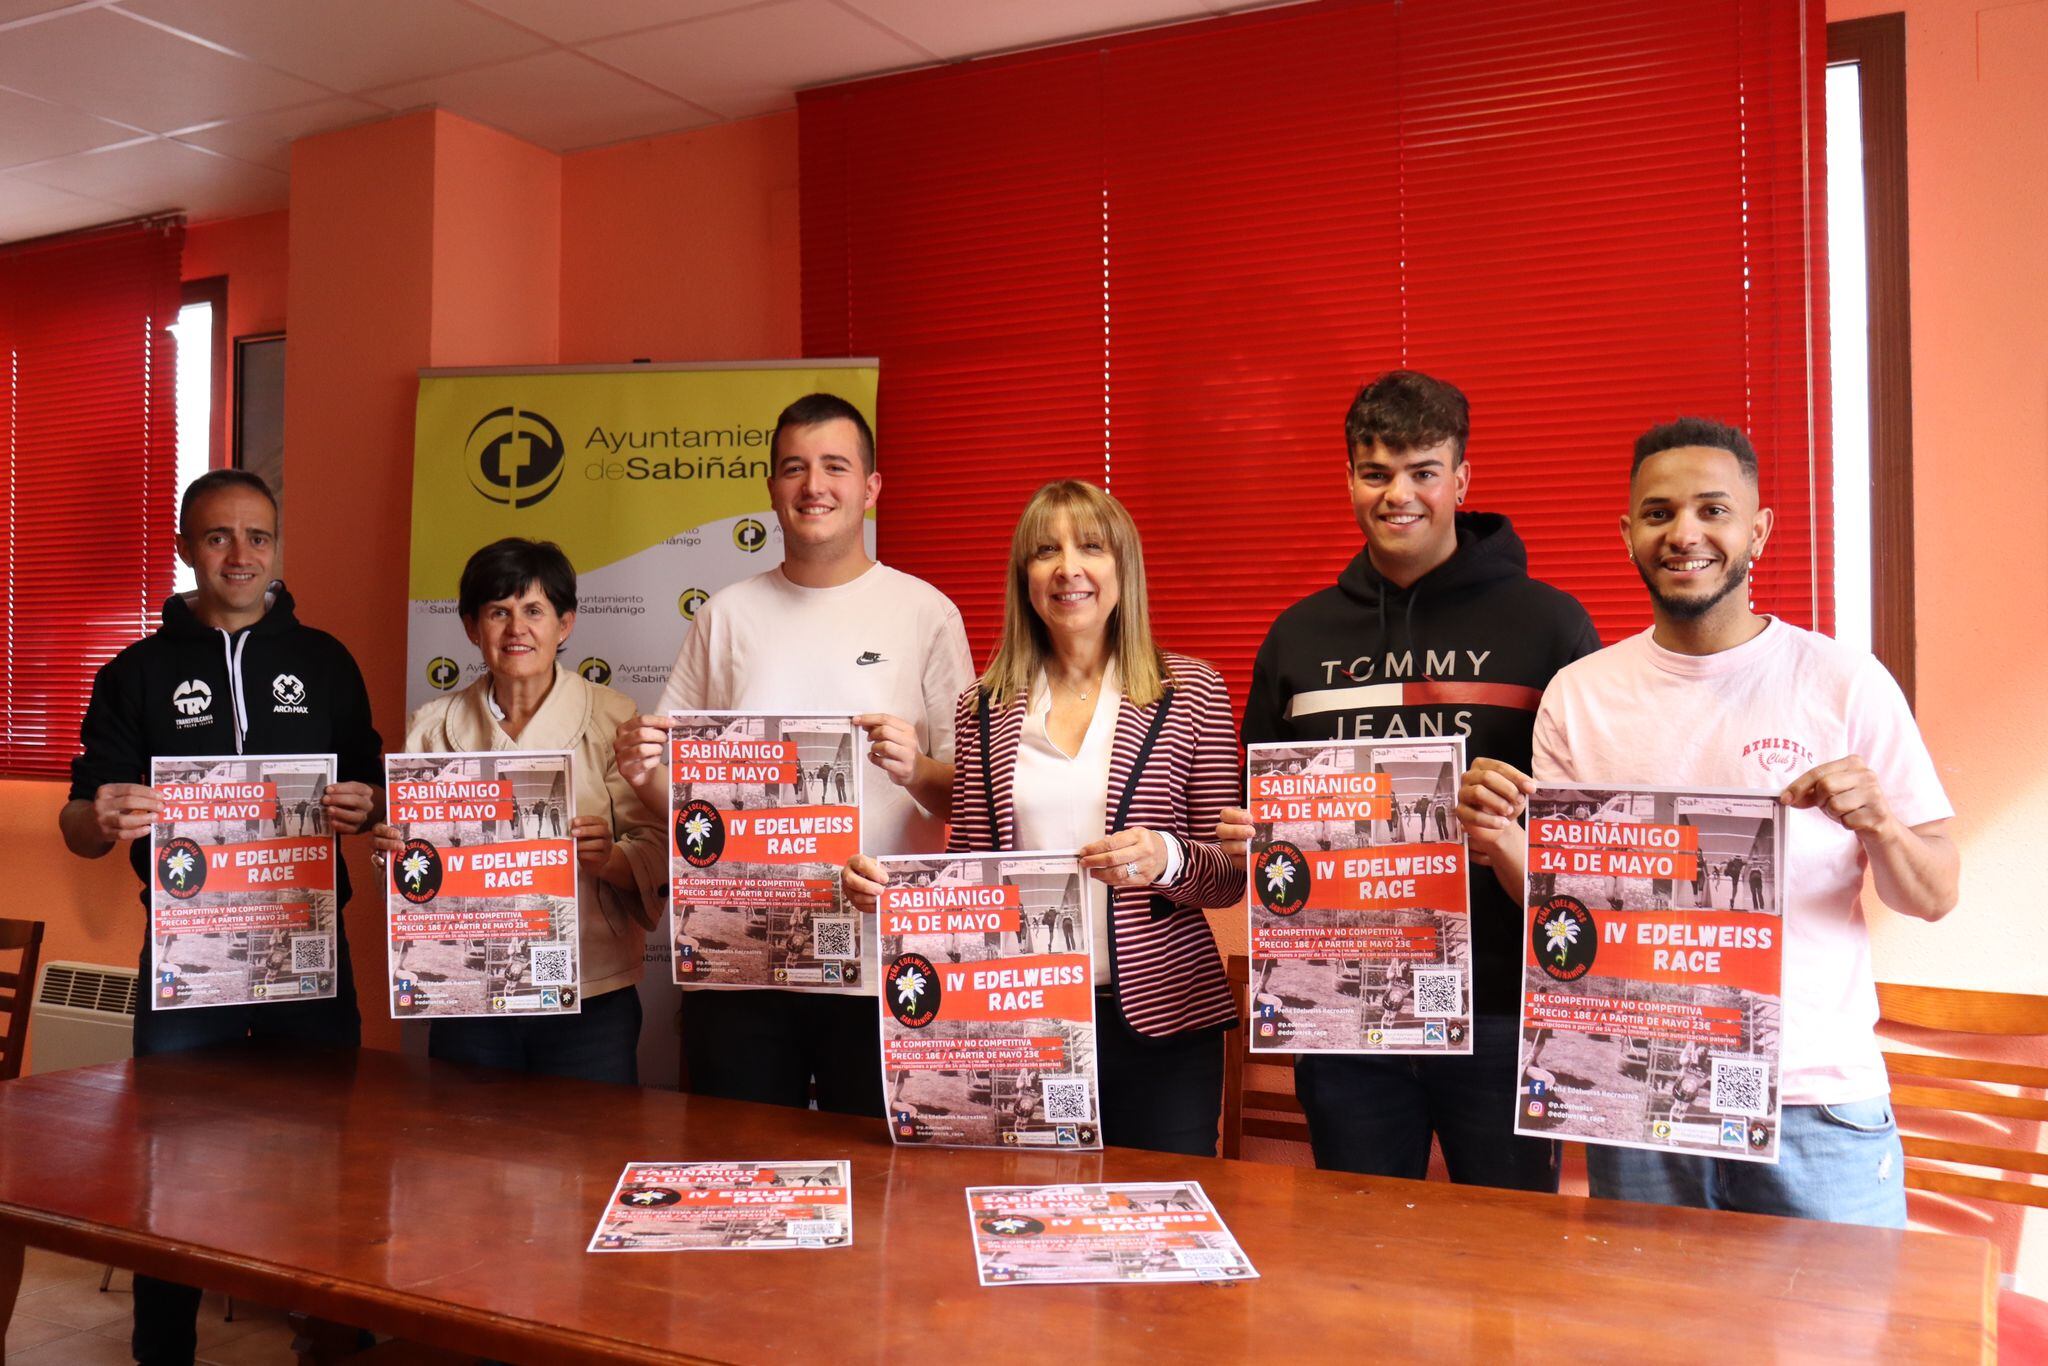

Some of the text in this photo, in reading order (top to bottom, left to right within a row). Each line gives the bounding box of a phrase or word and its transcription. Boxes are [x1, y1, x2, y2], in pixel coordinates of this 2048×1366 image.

[585, 424, 776, 454] Ayuntamien
[584, 456, 768, 481] deSabiñán
[577, 595, 644, 604] untamiento
[618, 663, 672, 673] Ayuntami
[1321, 650, 1491, 685] TOMMY
[293, 706, 308, 714] MAX
[1329, 711, 1473, 741] JEANS
[680, 741, 784, 760] SABIÑÁNIGO
[1742, 738, 1813, 764] ATHLETIC
[681, 766, 780, 781] 14 DE MAYO
[162, 783, 265, 801] SABIÑÁNIGO
[397, 782, 500, 800] SABIÑÁNIGO
[1260, 774, 1377, 795] SABIÑÁNIGO
[164, 804, 260, 820] 14 DE MAYO
[399, 804, 496, 820] 14 DE MAYO
[1260, 801, 1371, 820] 14 DE MAYO
[730, 817, 853, 836] IV EDELWEISS
[1540, 822, 1680, 848] SABIÑÁNIGO
[767, 837, 817, 855] RACE
[212, 846, 328, 868] IV EDELWEISS
[448, 849, 568, 872] IV EDELWEISS
[1540, 853, 1673, 876] 14 DE MAYO
[248, 865, 295, 884] RACE
[1316, 855, 1457, 880] IV EDELWEISS
[484, 869, 533, 889] RACE
[889, 887, 1005, 908] SABIÑÁNIGO
[1359, 879, 1416, 900] RACE
[161, 909, 170, 917] 8K
[172, 907, 217, 916] COMPETITIVA
[237, 905, 284, 913] COMPETITIVA
[217, 916, 241, 924] PARTIR
[408, 913, 454, 921] COMPETITIVA
[890, 913, 1000, 932] 14 DE MAYO
[1349, 928, 1403, 936] COMPETITIVA
[1604, 922, 1772, 949] IV EDELWEISS
[1653, 950, 1721, 973] RACE
[946, 965, 1084, 992] IV EDELWEISS
[989, 990, 1044, 1012] RACE
[1533, 994, 1702, 1016] 8K COMPETITIVA Y NO COMPETITIVA
[1533, 1008, 1571, 1019] PRECIO:
[1611, 1014, 1643, 1025] PARTIR
[1647, 1017, 1658, 1026] DE
[1662, 1018, 1689, 1028] MAYO
[903, 1040, 955, 1048] COMPETITIVA
[978, 1039, 1031, 1047] COMPETITIVA
[956, 1051, 983, 1059] PARTIR
[719, 1189, 839, 1198] EDELWEISS
[1082, 1215, 1207, 1225] EDELWEISS
[1102, 1222, 1165, 1231] RACE
